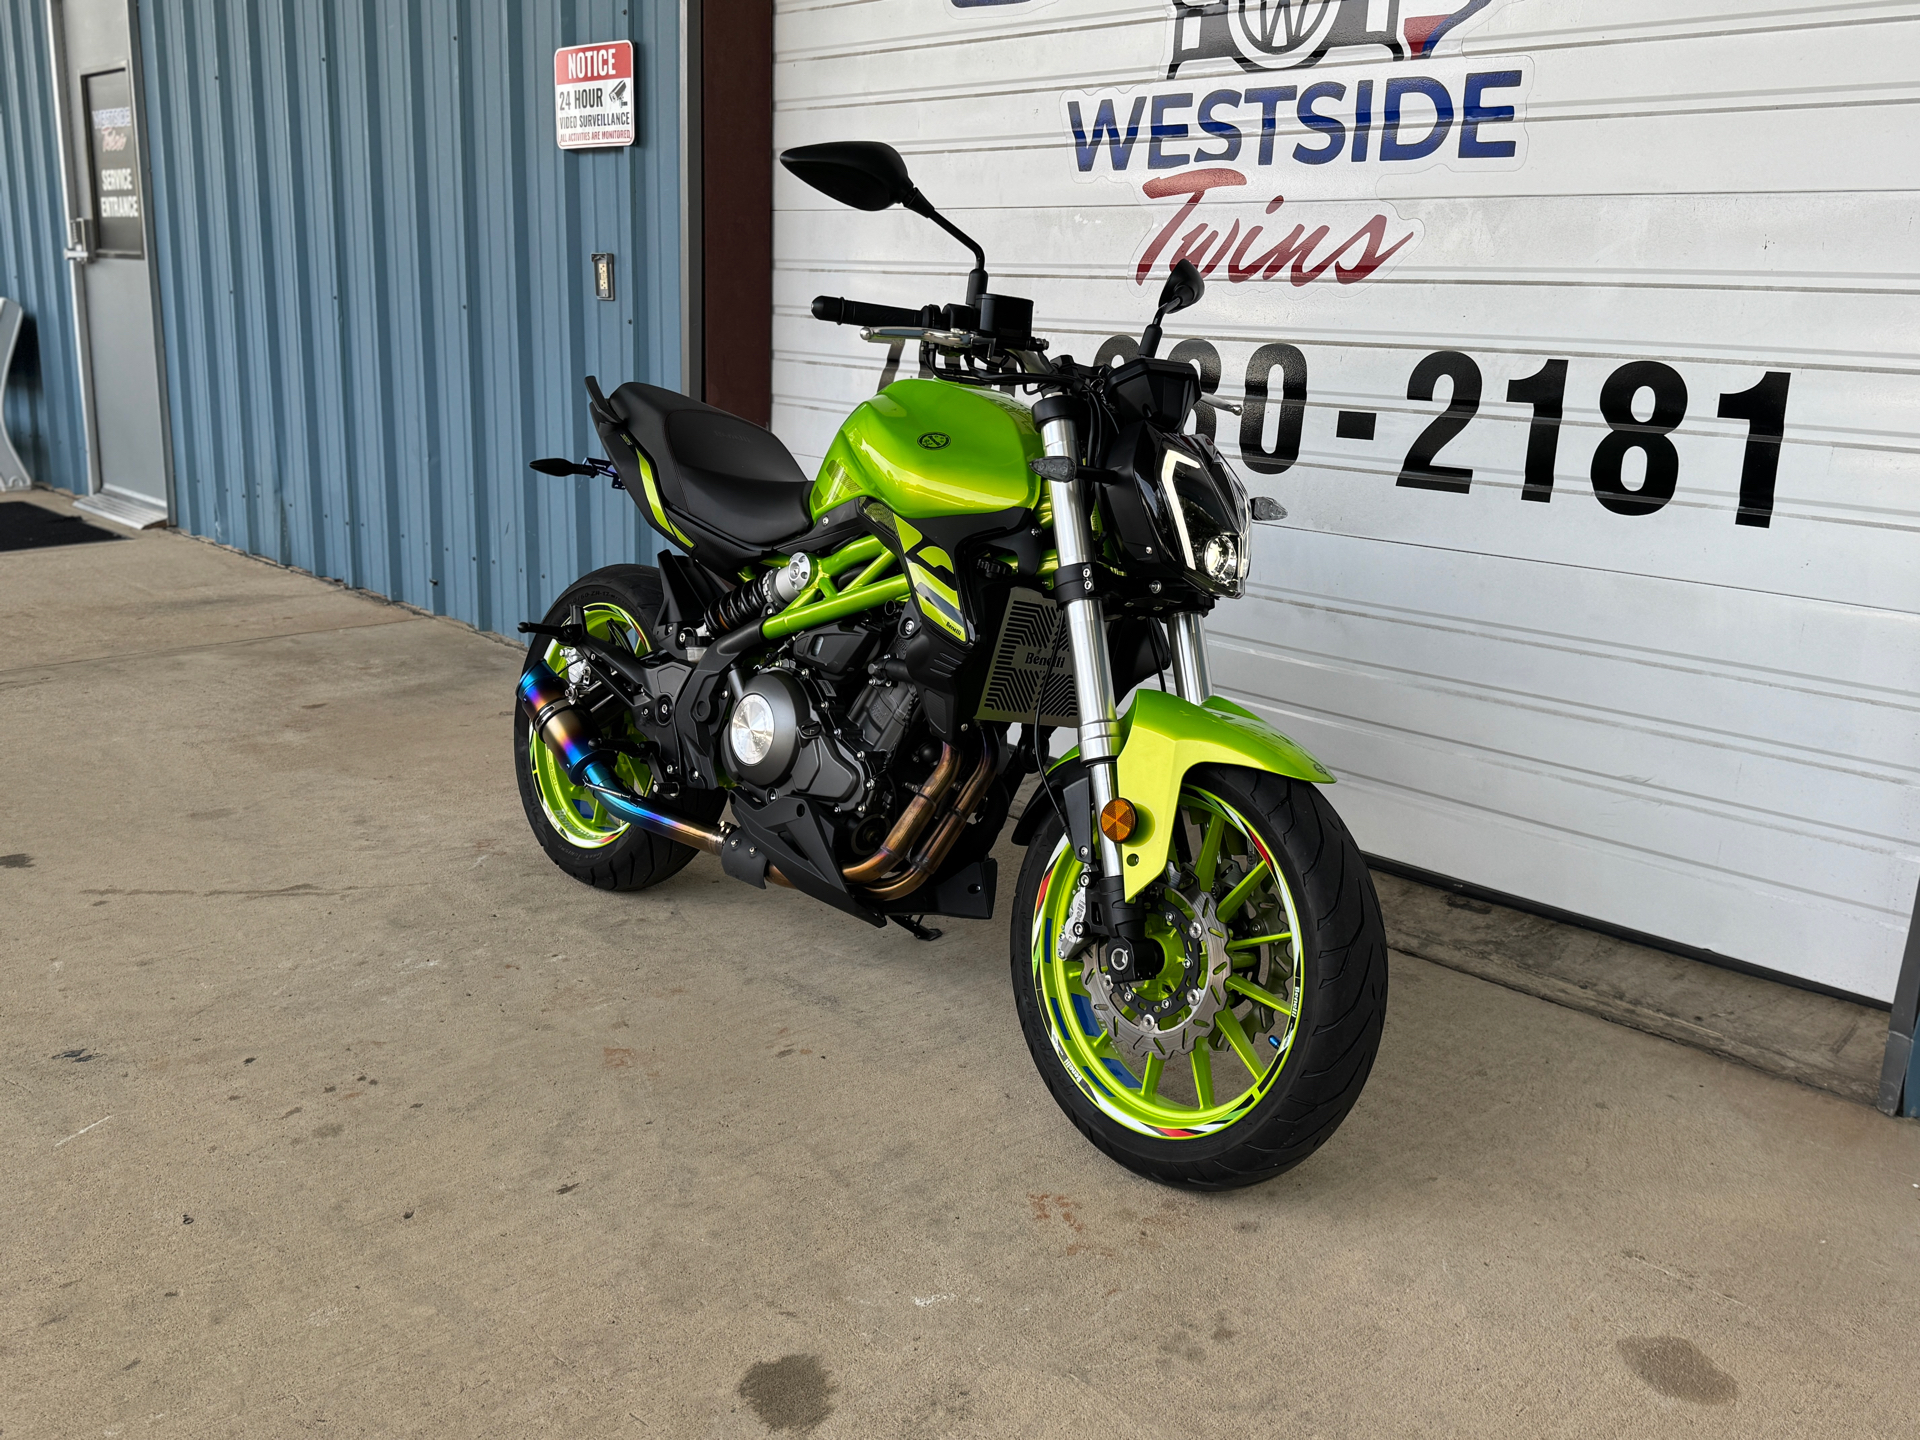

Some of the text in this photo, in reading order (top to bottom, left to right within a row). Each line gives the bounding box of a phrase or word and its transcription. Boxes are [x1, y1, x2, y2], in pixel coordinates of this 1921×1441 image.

[568, 49, 616, 79] NOTICE
[559, 87, 604, 111] 24 HOUR
[559, 111, 630, 130] VIDEO SURVEILLANCE
[1066, 69, 1523, 173] WESTSIDE
[568, 131, 591, 142] ACTIVITIES
[591, 130, 601, 140] ARE
[101, 168, 133, 190] SERVICE
[100, 195, 139, 218] ENTRANCE
[1135, 167, 1415, 288] Twins
[1024, 652, 1066, 669] Beneli
[1291, 986, 1300, 1018] Benelli
[1064, 1058, 1083, 1083] Benelli
